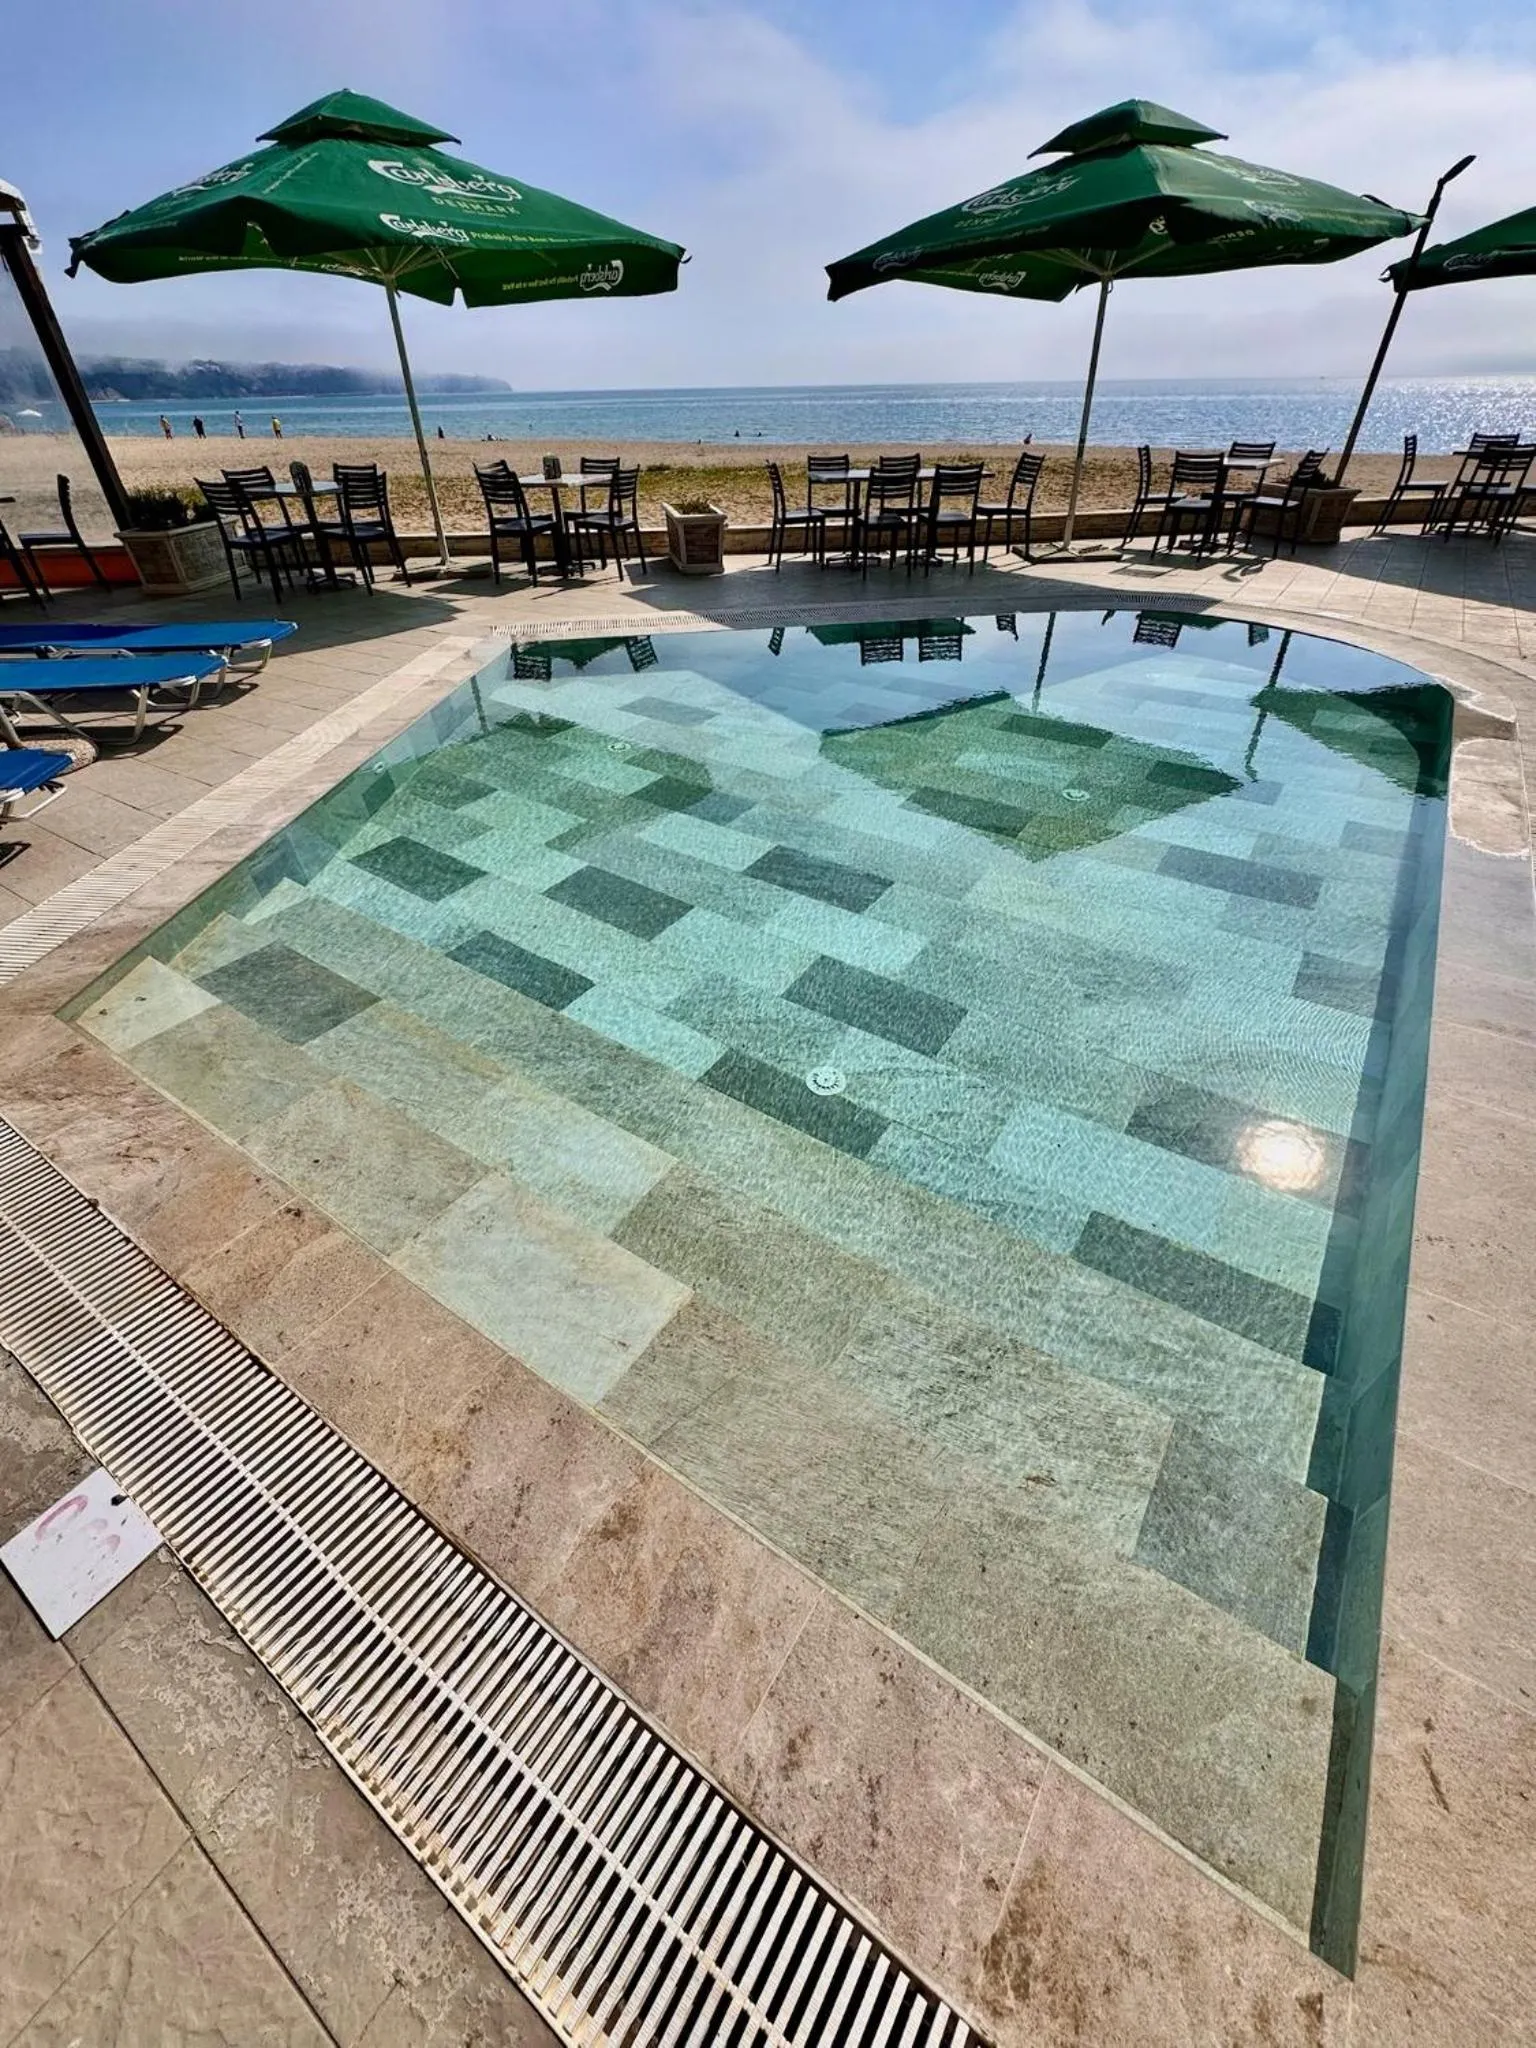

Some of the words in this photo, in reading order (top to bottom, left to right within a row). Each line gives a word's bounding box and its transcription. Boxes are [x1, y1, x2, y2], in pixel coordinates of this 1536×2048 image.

[367, 160, 522, 201] Carlsberg
[431, 197, 521, 214] DENMARK
[379, 213, 470, 243] Carlsberg
